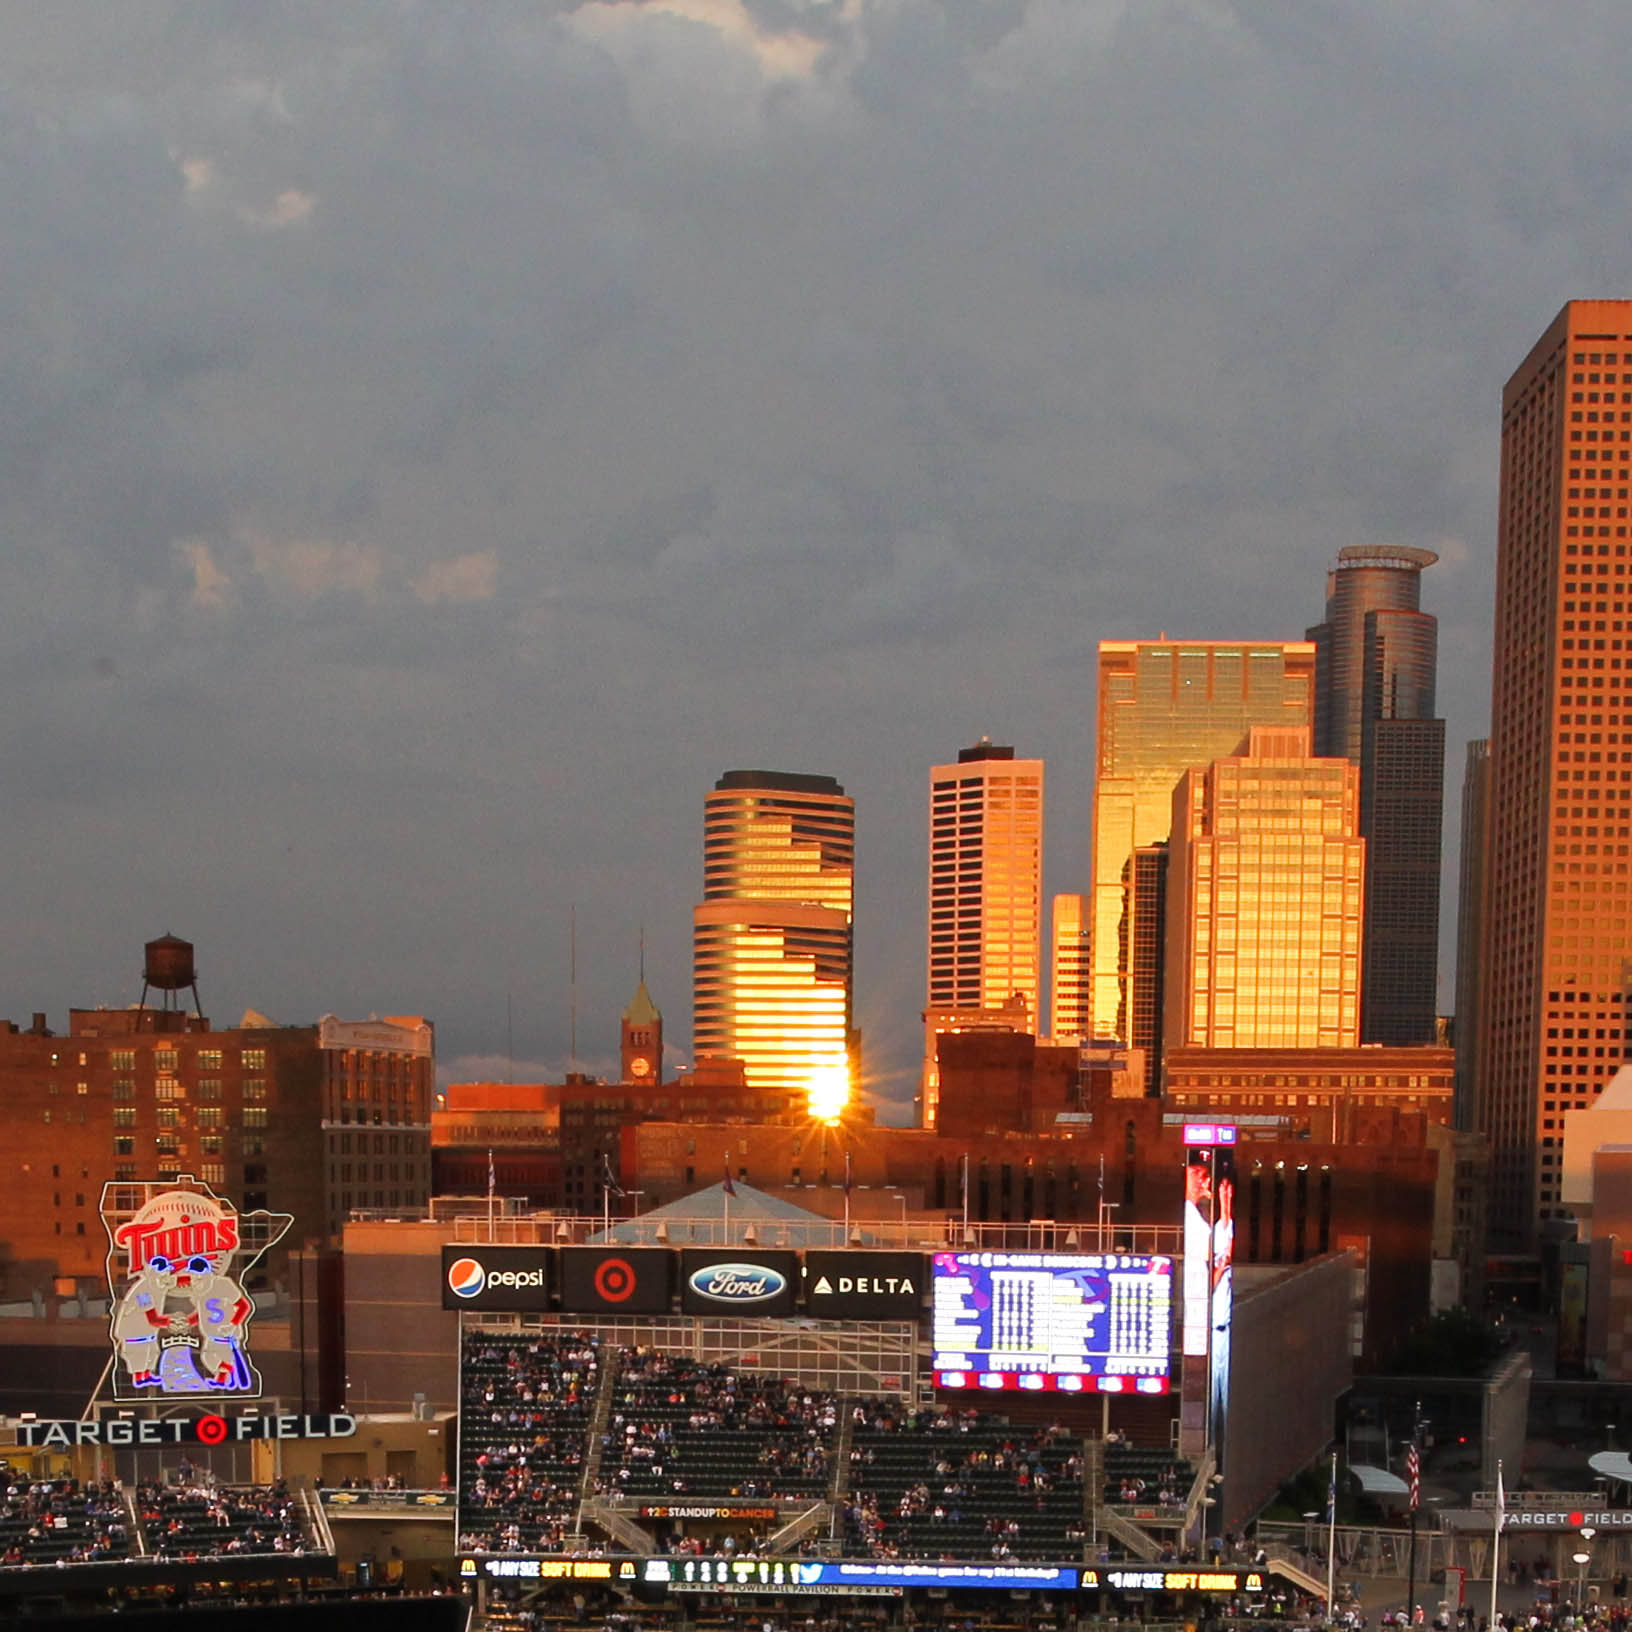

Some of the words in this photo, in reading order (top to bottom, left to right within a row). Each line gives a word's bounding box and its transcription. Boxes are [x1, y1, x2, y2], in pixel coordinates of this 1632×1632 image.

[116, 1213, 240, 1276] Twins
[487, 1268, 544, 1290] pepsi
[707, 1270, 768, 1297] Ford
[838, 1278, 915, 1294] DELTA
[18, 1419, 190, 1447] TARGET
[236, 1414, 358, 1441] FIELD
[1501, 1513, 1567, 1525] TARGET
[500, 1561, 519, 1577] ANY
[520, 1561, 540, 1577] SIZE
[541, 1561, 573, 1578] SOFT
[574, 1561, 611, 1578] DRINK
[792, 1585, 840, 1594] PAVILION
[1123, 1573, 1141, 1588] ANY
[1143, 1573, 1165, 1589] SIZE
[1166, 1573, 1199, 1590] SOFT
[1199, 1573, 1237, 1591] DRINK
